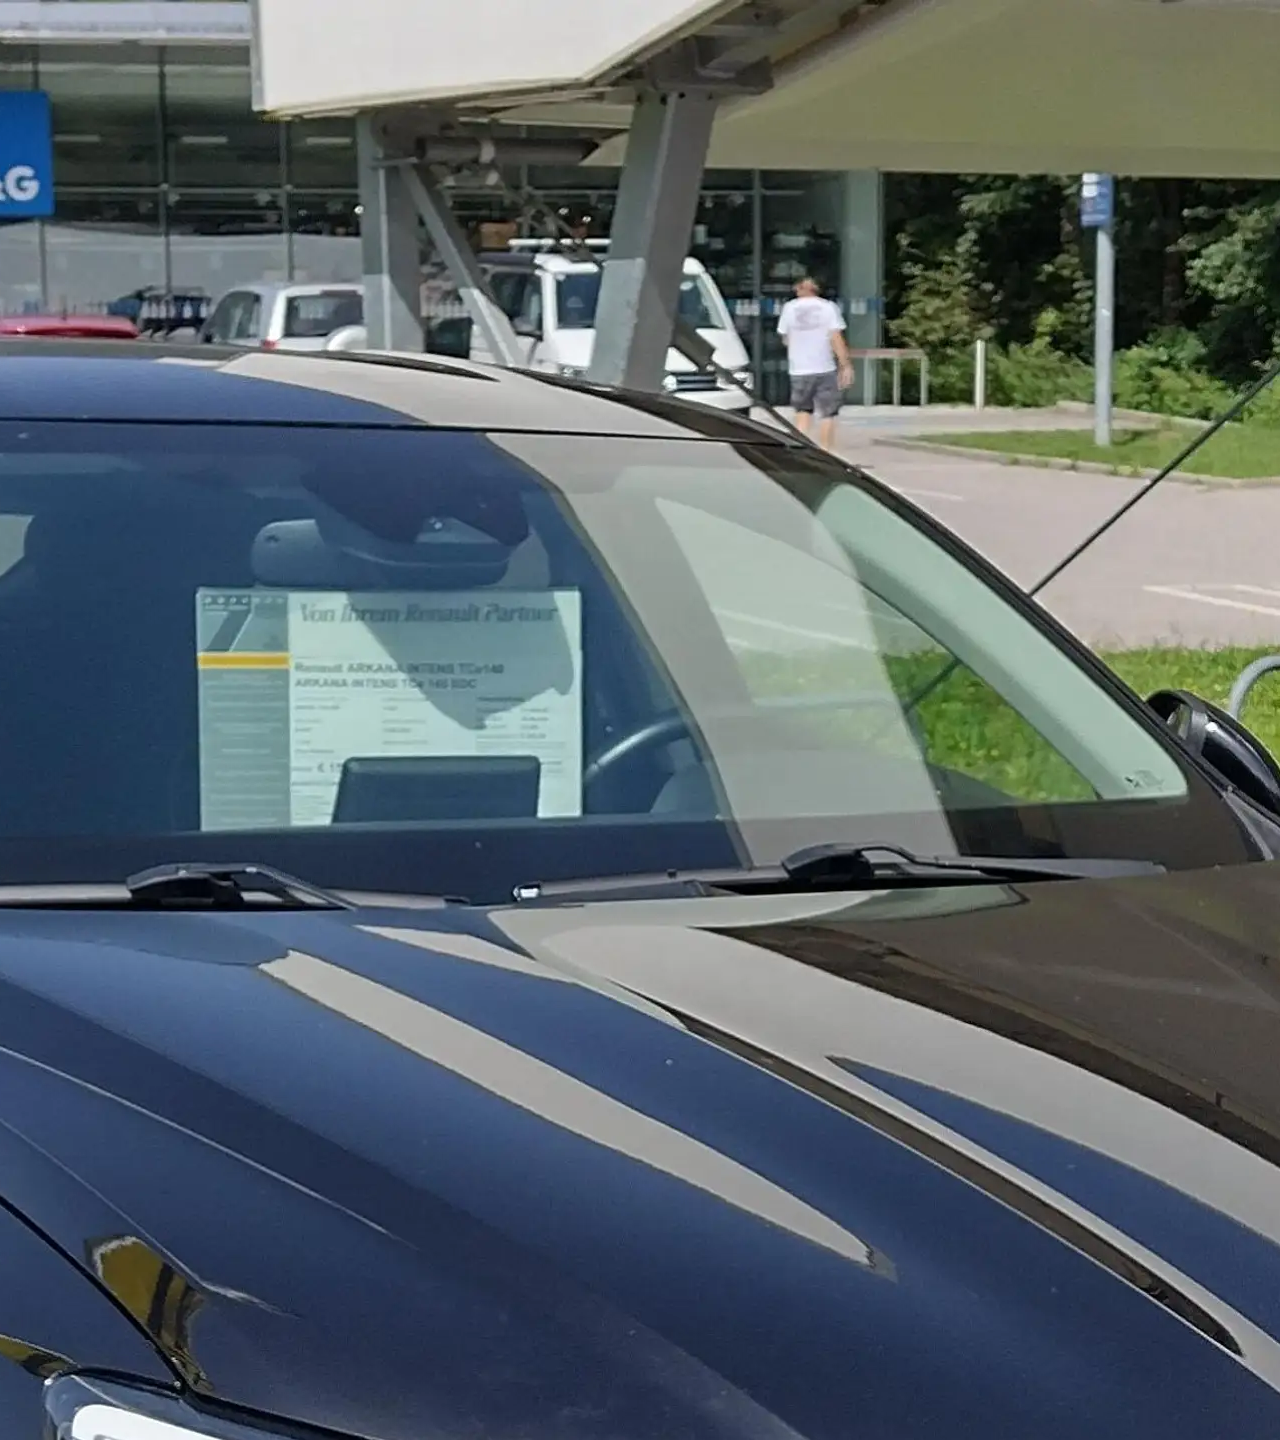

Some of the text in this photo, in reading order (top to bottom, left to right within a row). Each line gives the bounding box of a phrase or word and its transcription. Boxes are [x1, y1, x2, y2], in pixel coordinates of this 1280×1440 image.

[301, 603, 335, 622] Von
[404, 602, 479, 623] Renault
[484, 602, 557, 622] Partner
